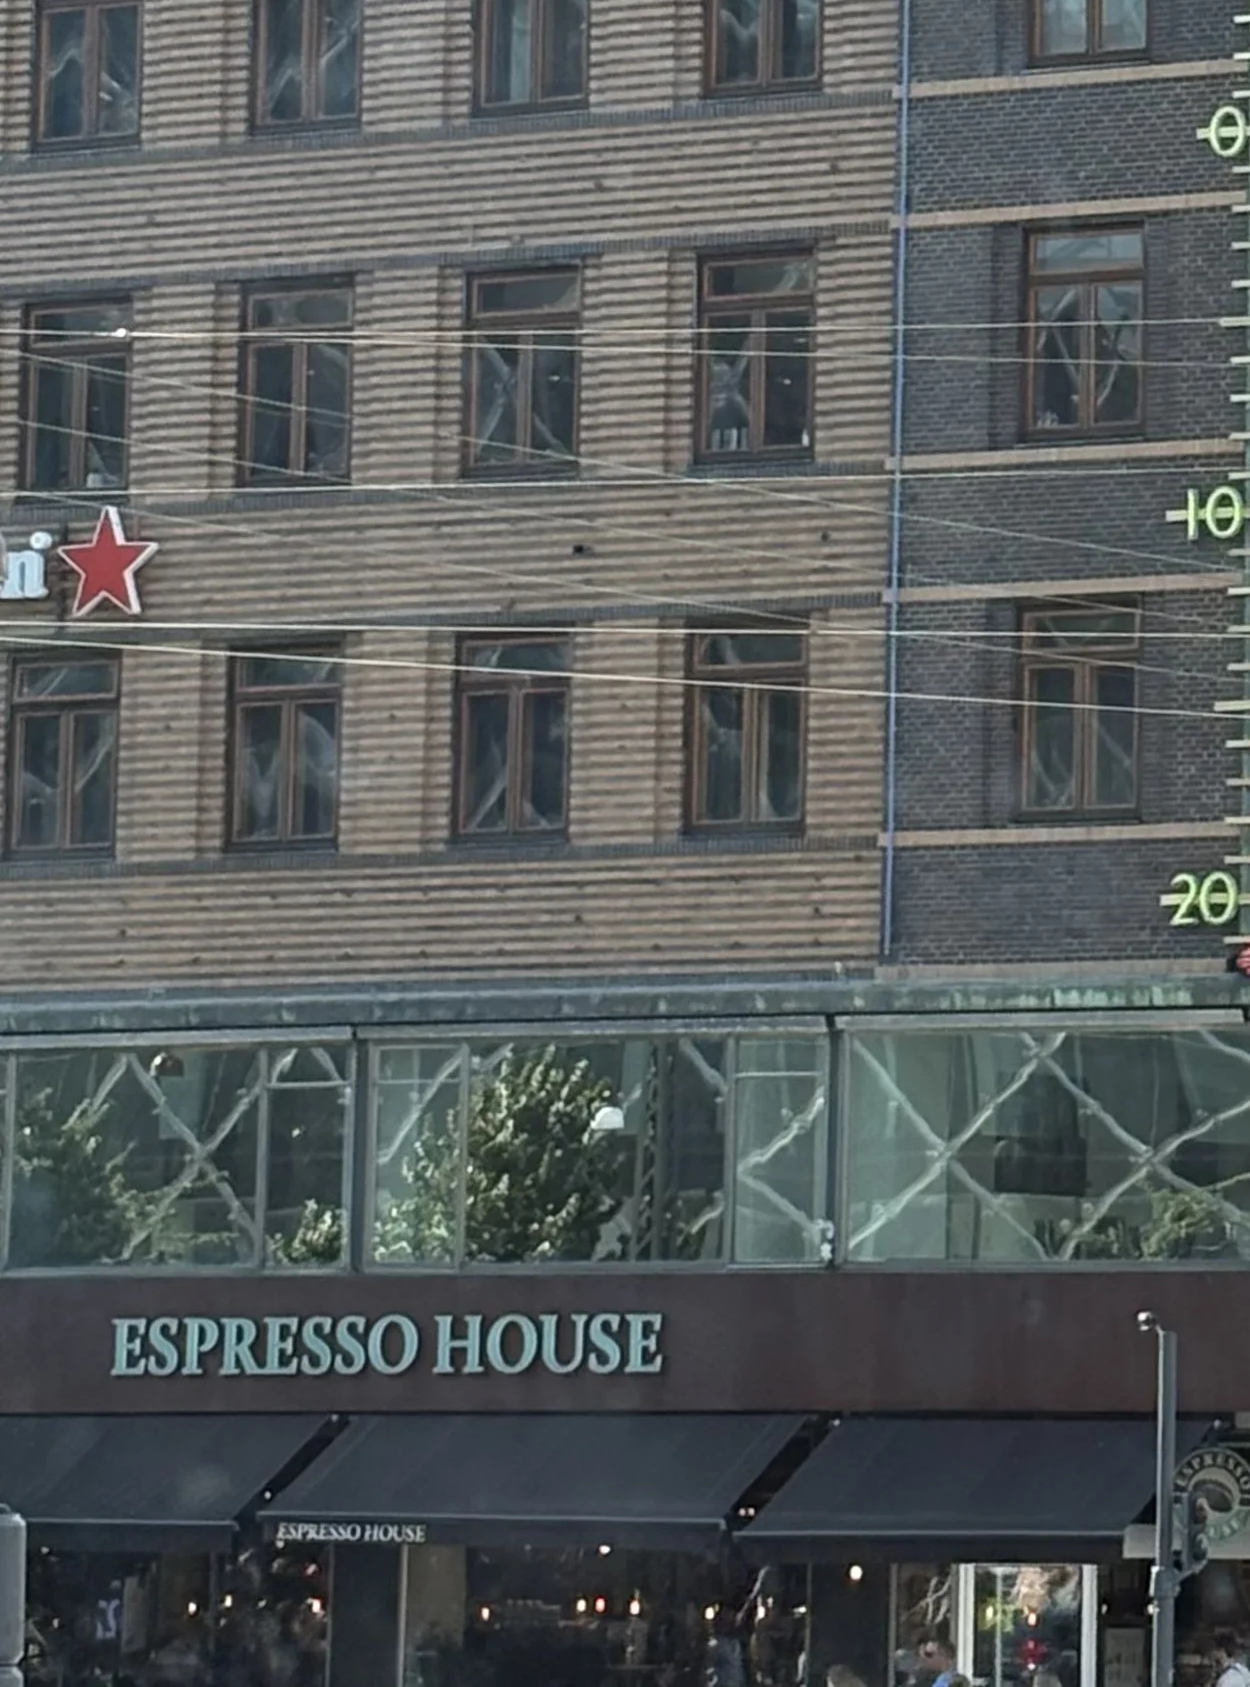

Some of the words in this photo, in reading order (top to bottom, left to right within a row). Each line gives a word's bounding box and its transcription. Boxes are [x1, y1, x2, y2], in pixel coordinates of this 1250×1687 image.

[1187, 486, 1243, 540] 10
[1170, 871, 1238, 926] 20
[110, 1314, 418, 1375] ESPRESSO
[431, 1312, 662, 1374] HOUSE
[276, 1522, 361, 1541] ESPRESSO
[363, 1523, 427, 1543] HOUSE
